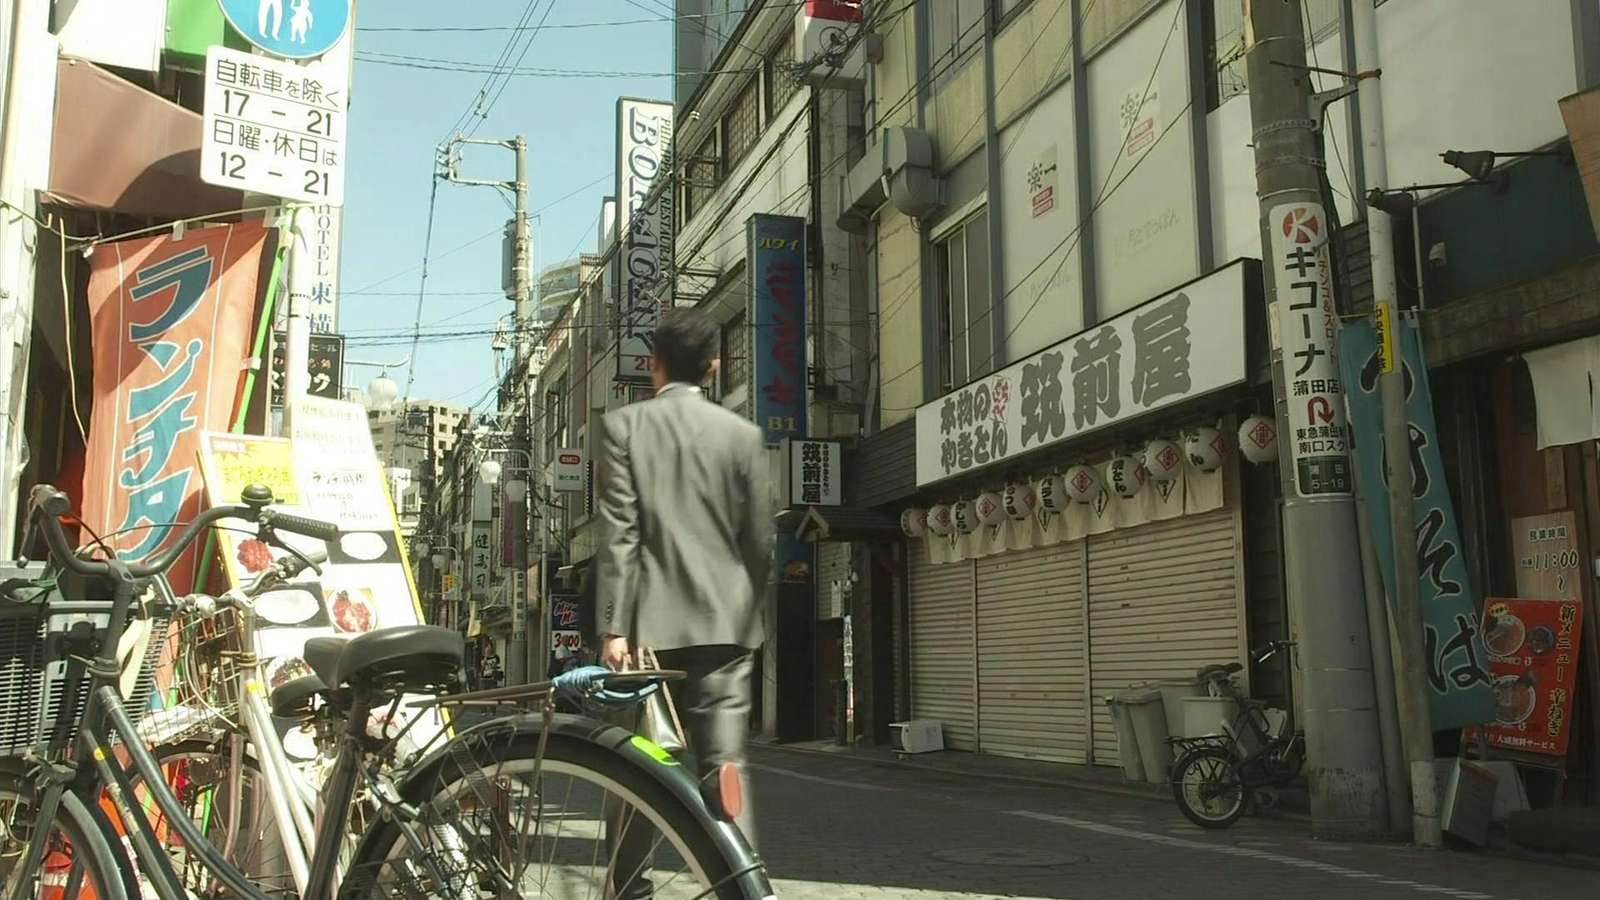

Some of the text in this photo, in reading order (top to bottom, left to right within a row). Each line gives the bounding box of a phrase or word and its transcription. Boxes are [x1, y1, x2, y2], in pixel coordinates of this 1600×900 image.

[216, 59, 340, 108] 自転車を除く
[223, 90, 250, 116] 17
[306, 110, 332, 136] 21
[220, 152, 246, 180] 12
[303, 170, 329, 196] 21
[659, 196, 671, 276] RESTAURAN
[760, 238, 799, 251] ハワイ
[1285, 247, 1325, 377] キコーナ
[1020, 292, 1192, 448] 筑前屋
[1293, 378, 1340, 396] 蒲田店
[115, 245, 214, 563] ランチタ
[768, 416, 798, 431] B1
[941, 383, 991, 436] 本物の
[802, 442, 821, 503] 筑前屋
[941, 421, 1008, 475] やきとん
[1535, 550, 1579, 571] 11:00
[554, 633, 580, 648] 300
[1556, 604, 1575, 682] 新メニュー
